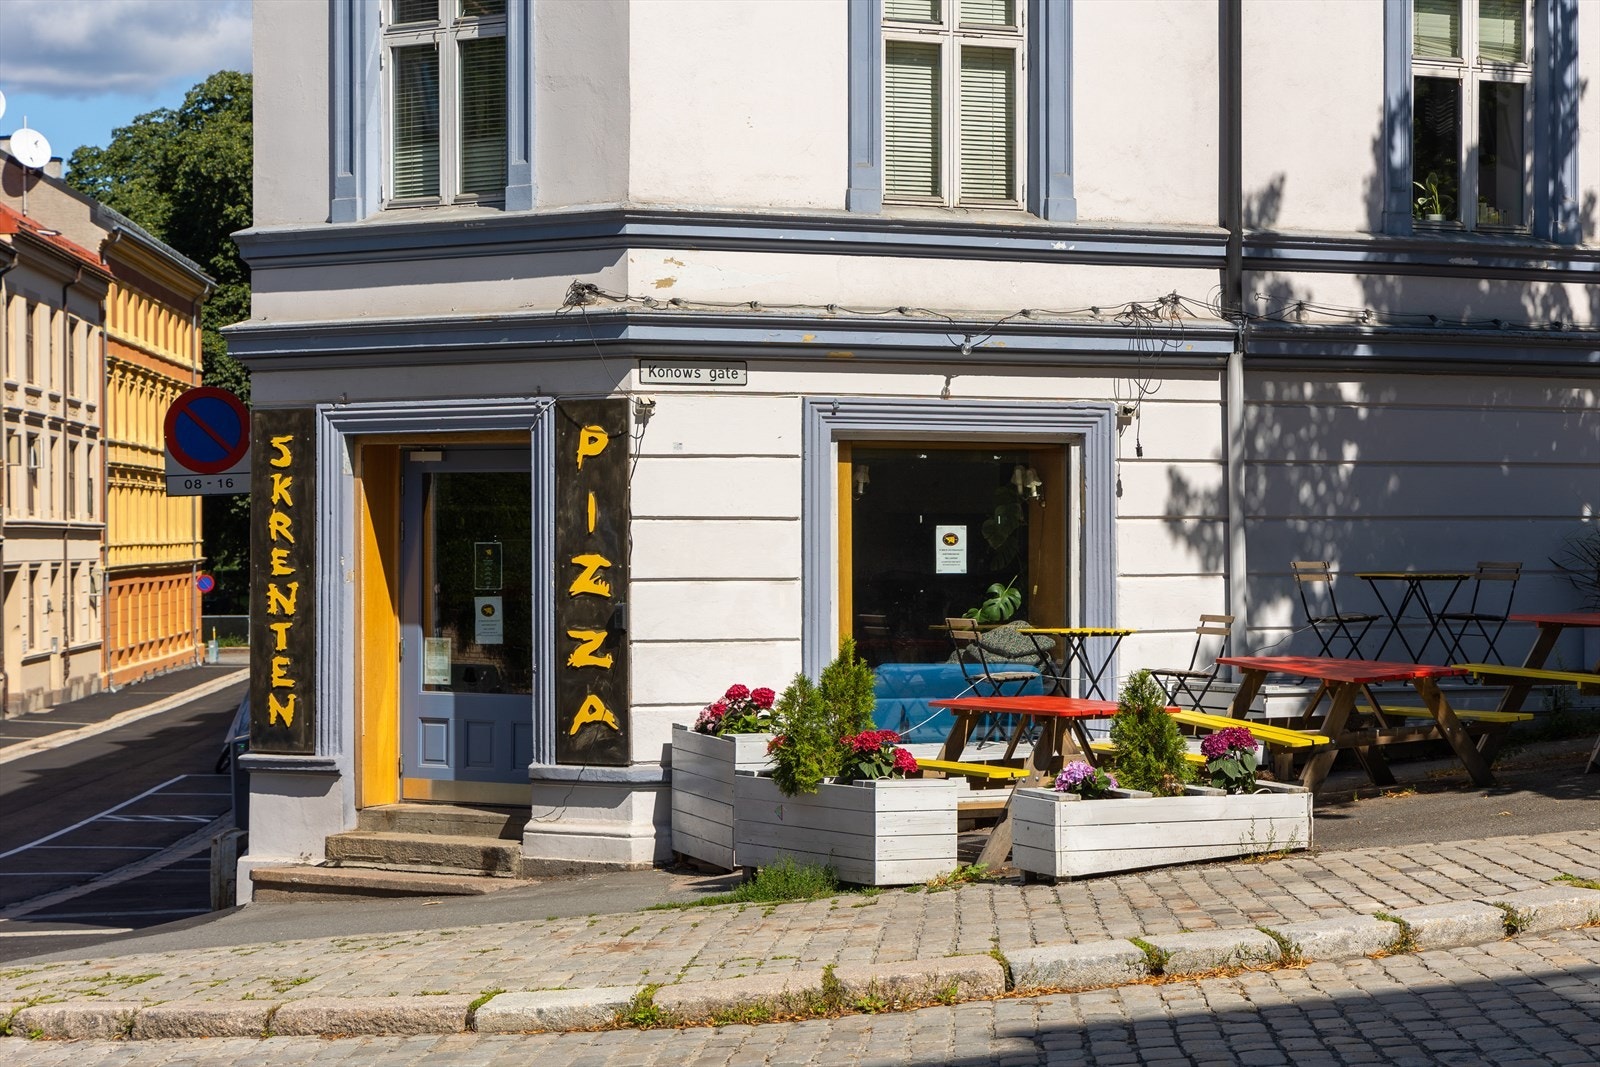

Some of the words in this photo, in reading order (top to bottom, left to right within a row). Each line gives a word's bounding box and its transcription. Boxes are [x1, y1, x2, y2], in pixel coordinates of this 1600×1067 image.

[648, 365, 701, 379] Konows
[709, 367, 739, 382] gate
[184, 479, 202, 490] 08
[217, 478, 234, 489] 16
[266, 435, 299, 728] SKRENTEN
[566, 425, 619, 736] PIZZA
